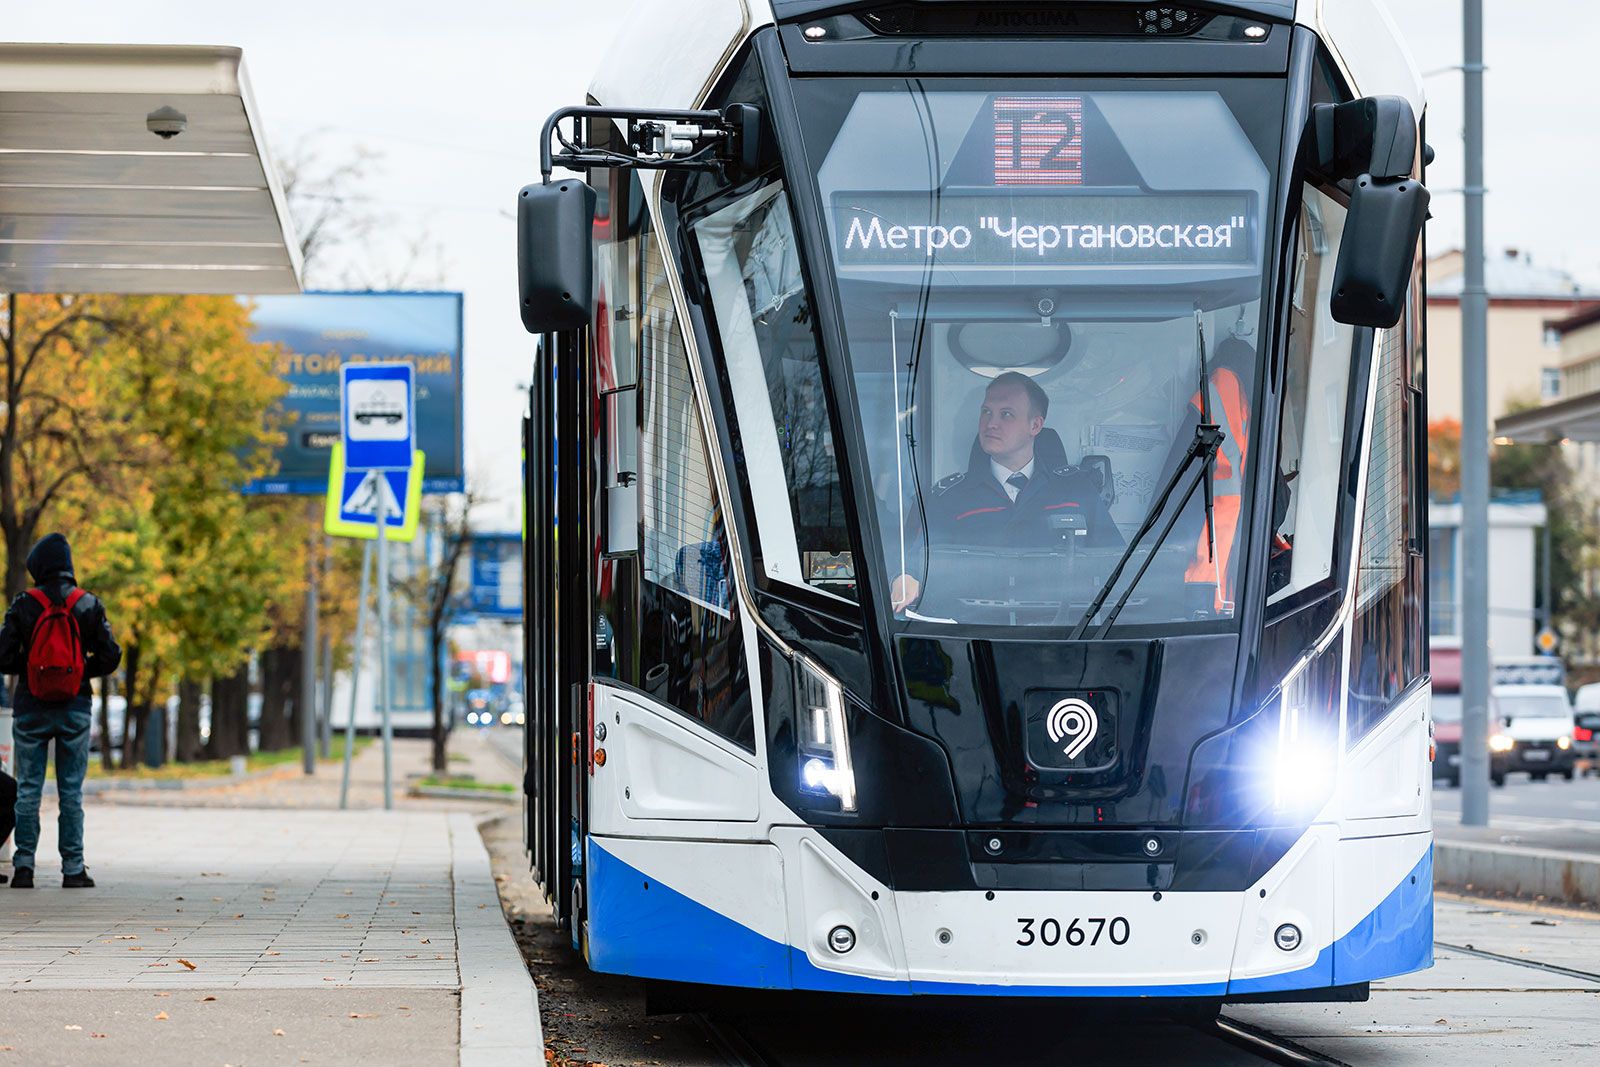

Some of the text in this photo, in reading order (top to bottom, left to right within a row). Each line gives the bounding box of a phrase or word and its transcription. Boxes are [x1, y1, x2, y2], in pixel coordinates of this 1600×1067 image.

[844, 216, 1245, 256] Метро "Чертановская"
[1016, 916, 1130, 947] 30670
